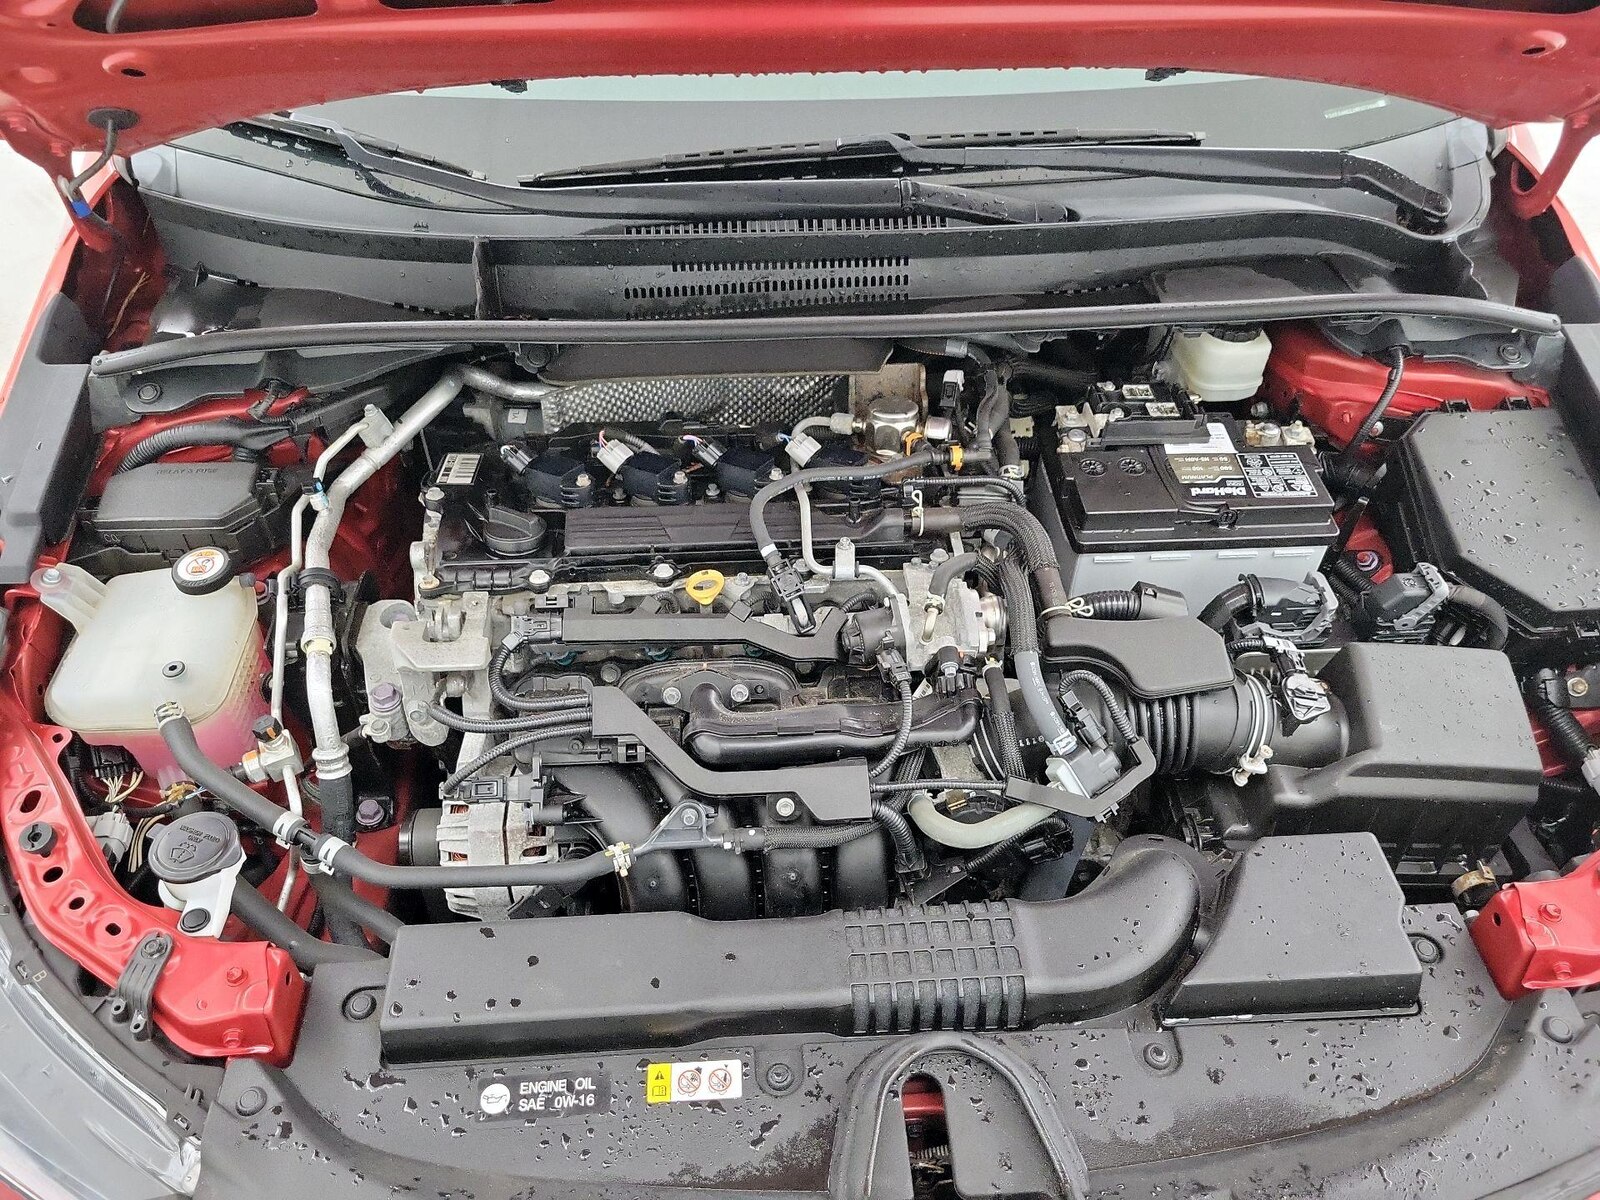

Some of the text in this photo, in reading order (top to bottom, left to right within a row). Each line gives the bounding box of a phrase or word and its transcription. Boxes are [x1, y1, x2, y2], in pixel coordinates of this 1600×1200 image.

[1191, 487, 1247, 497] DieHard
[519, 1077, 597, 1095] ENGINE OIL
[518, 1094, 595, 1112] SAE 0W-16
